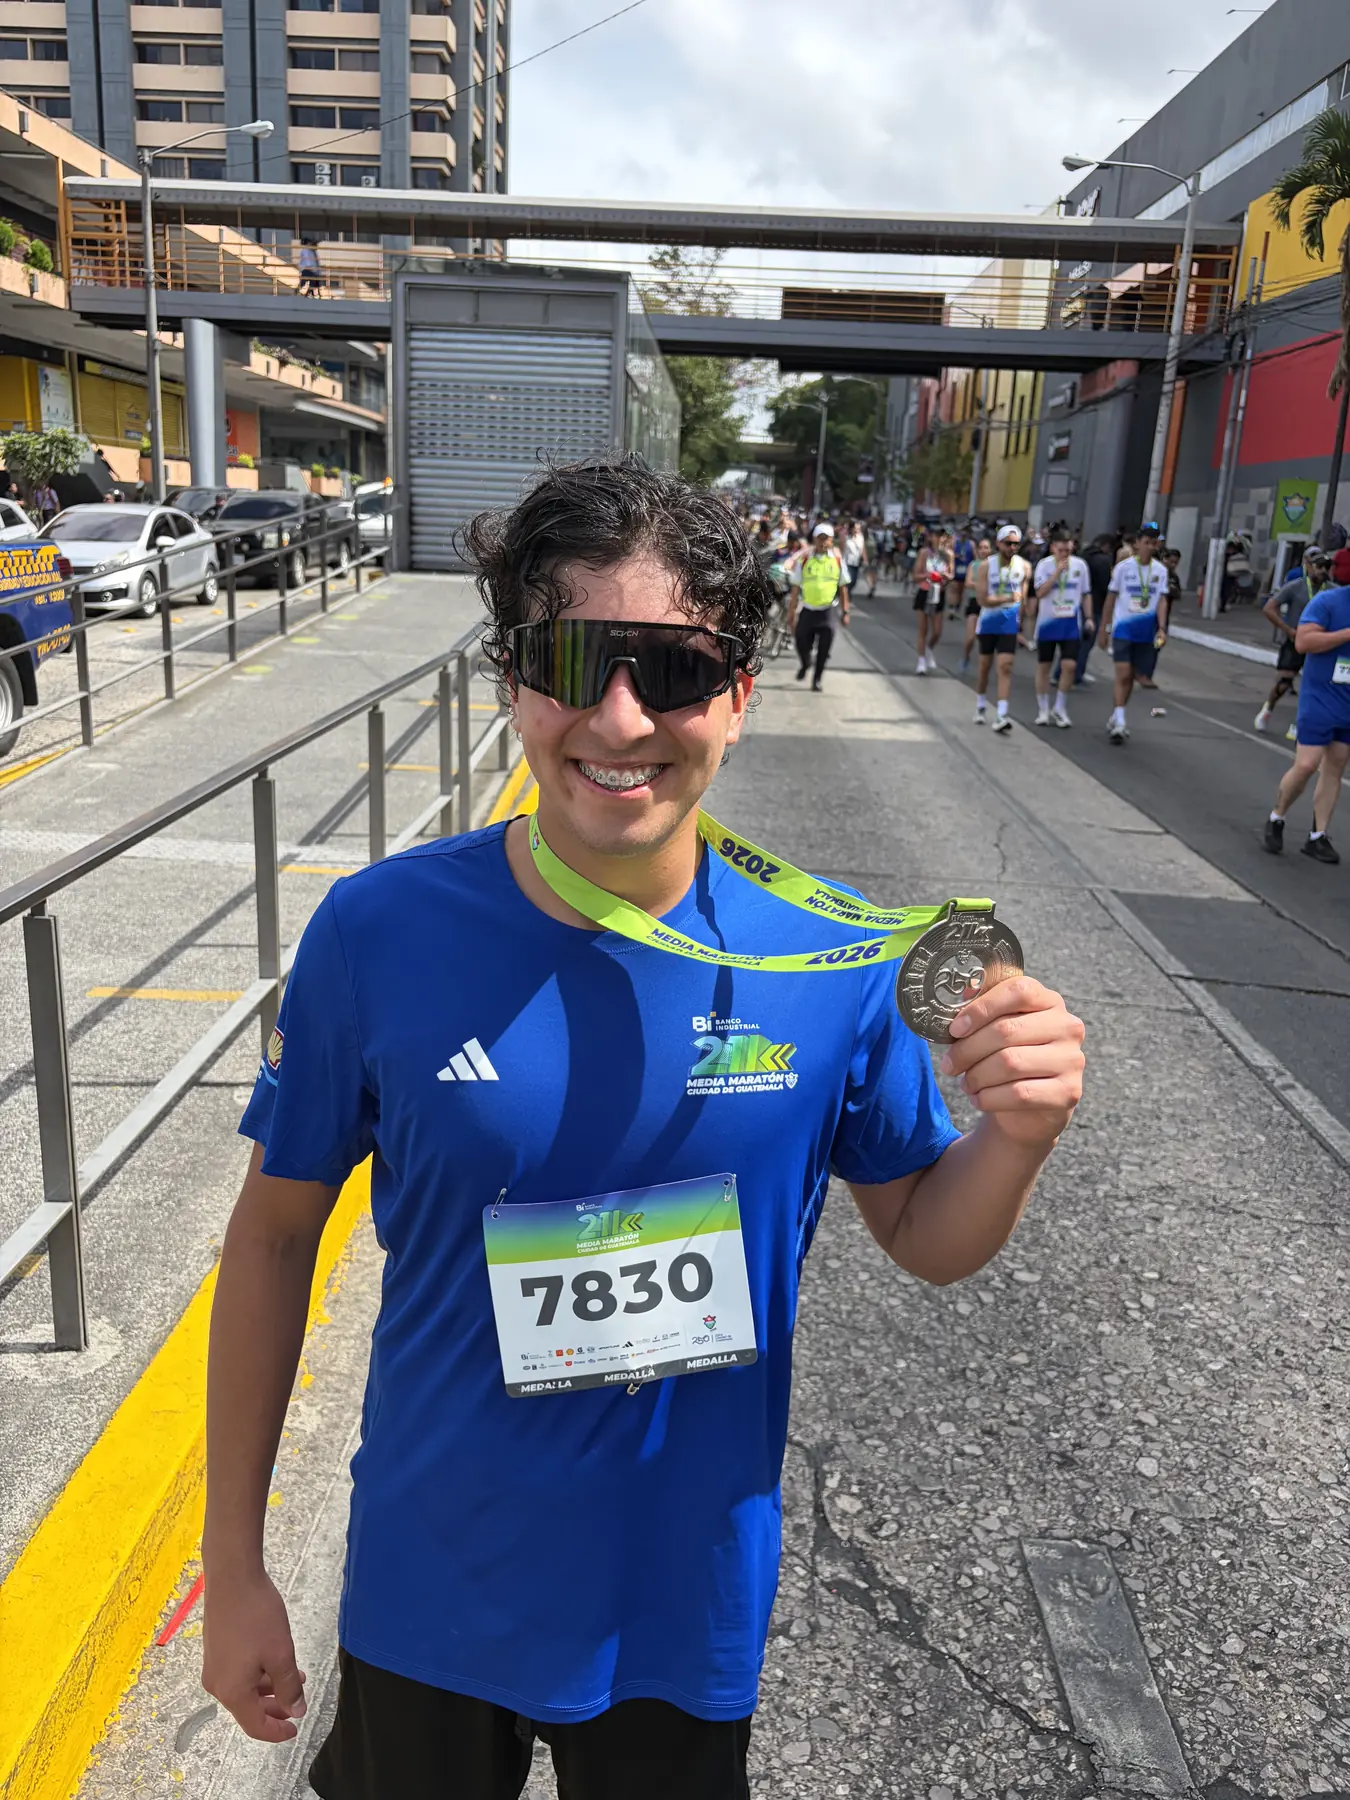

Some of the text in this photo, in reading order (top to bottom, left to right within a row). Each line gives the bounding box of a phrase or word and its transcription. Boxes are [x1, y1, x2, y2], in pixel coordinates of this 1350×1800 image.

[719, 838, 781, 883] 2026
[804, 895, 906, 926] MEDIA MARATÓN
[651, 928, 694, 952] MEDIA
[804, 940, 886, 966] 2026
[715, 1023, 760, 1031] INDUSTRIAL
[686, 1072, 784, 1088] MEDIA MARATÓN
[687, 1087, 721, 1095] CIUDAD
[735, 1083, 784, 1092] GUATEMALA
[576, 1232, 640, 1249] MEDIA MARATÓN
[520, 1251, 713, 1326] 7830
[686, 1353, 738, 1370] MEDALLA
[603, 1367, 656, 1383] MEDALLA
